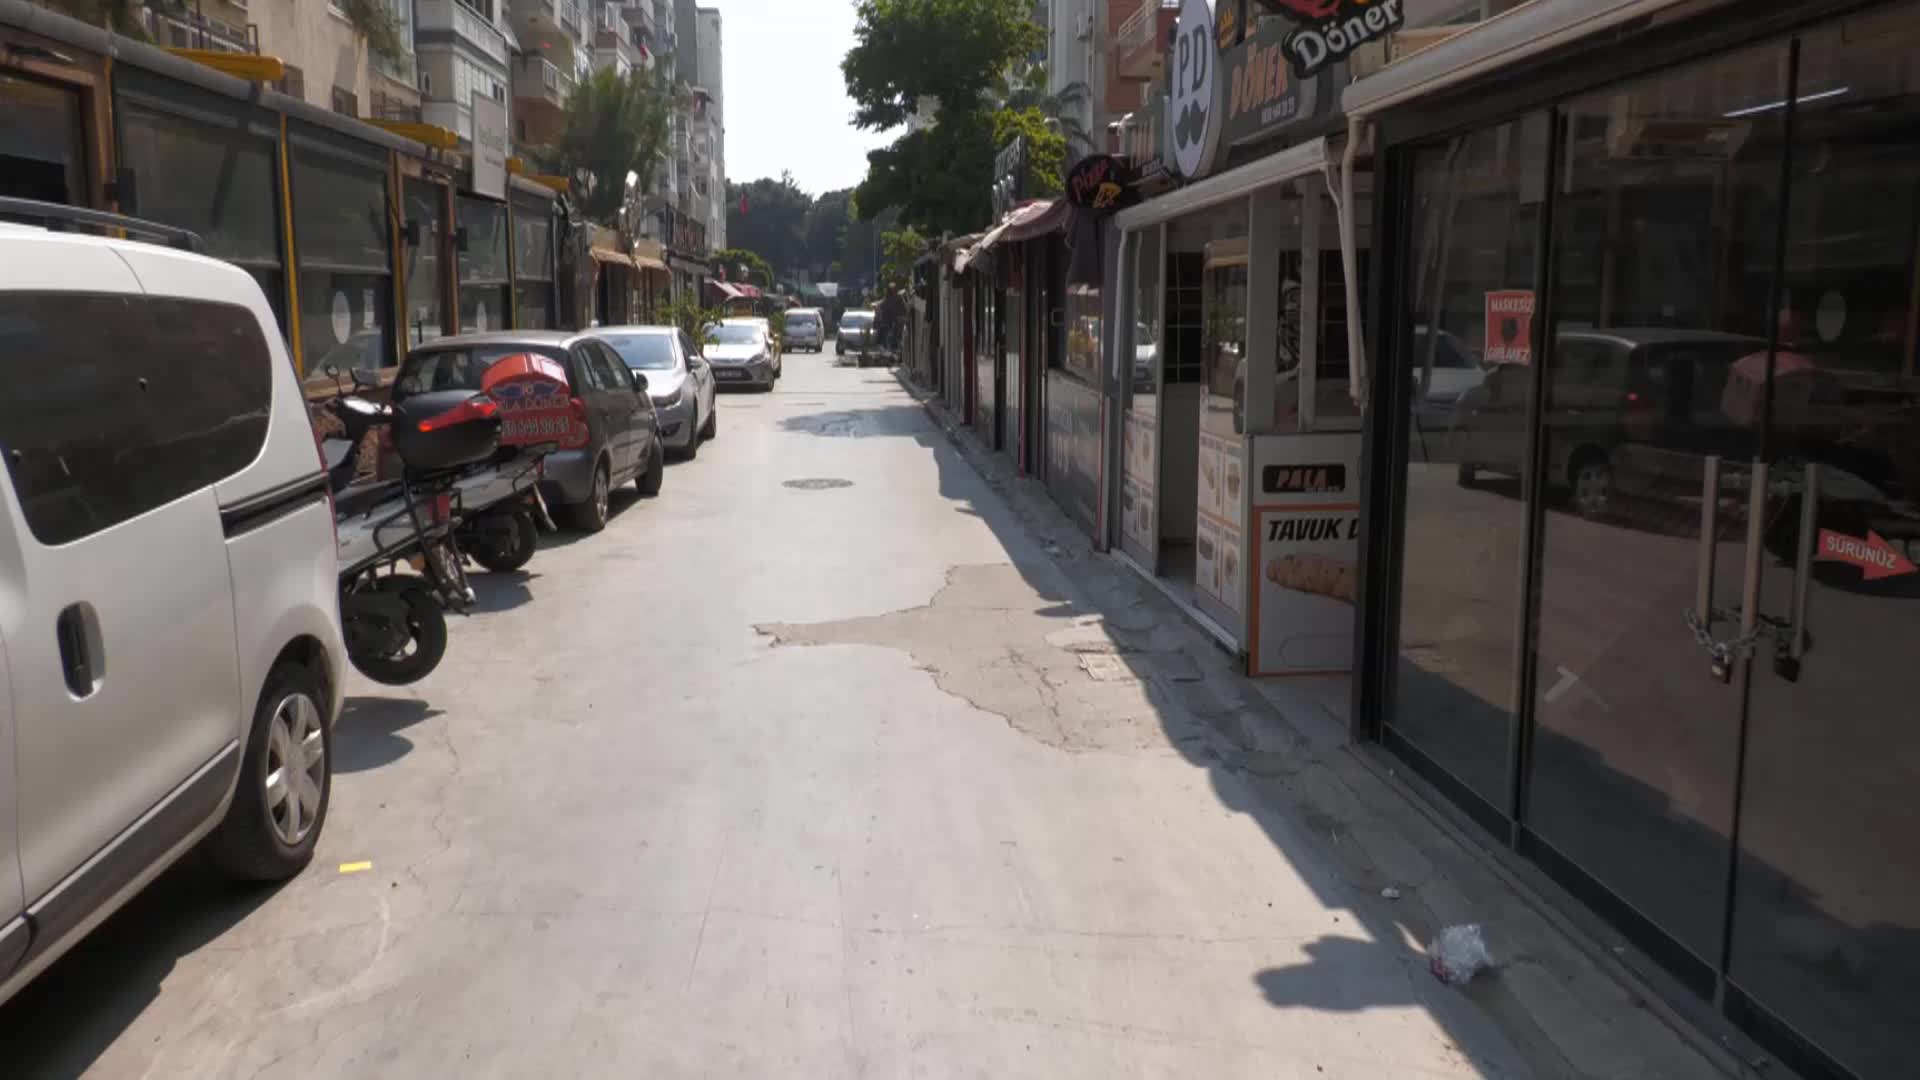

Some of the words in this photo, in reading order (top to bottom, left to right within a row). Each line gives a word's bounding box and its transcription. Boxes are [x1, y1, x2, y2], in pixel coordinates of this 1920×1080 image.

[1178, 24, 1207, 98] PD
[1291, 0, 1399, 70] Döner
[1268, 518, 1344, 541] TAVUK
